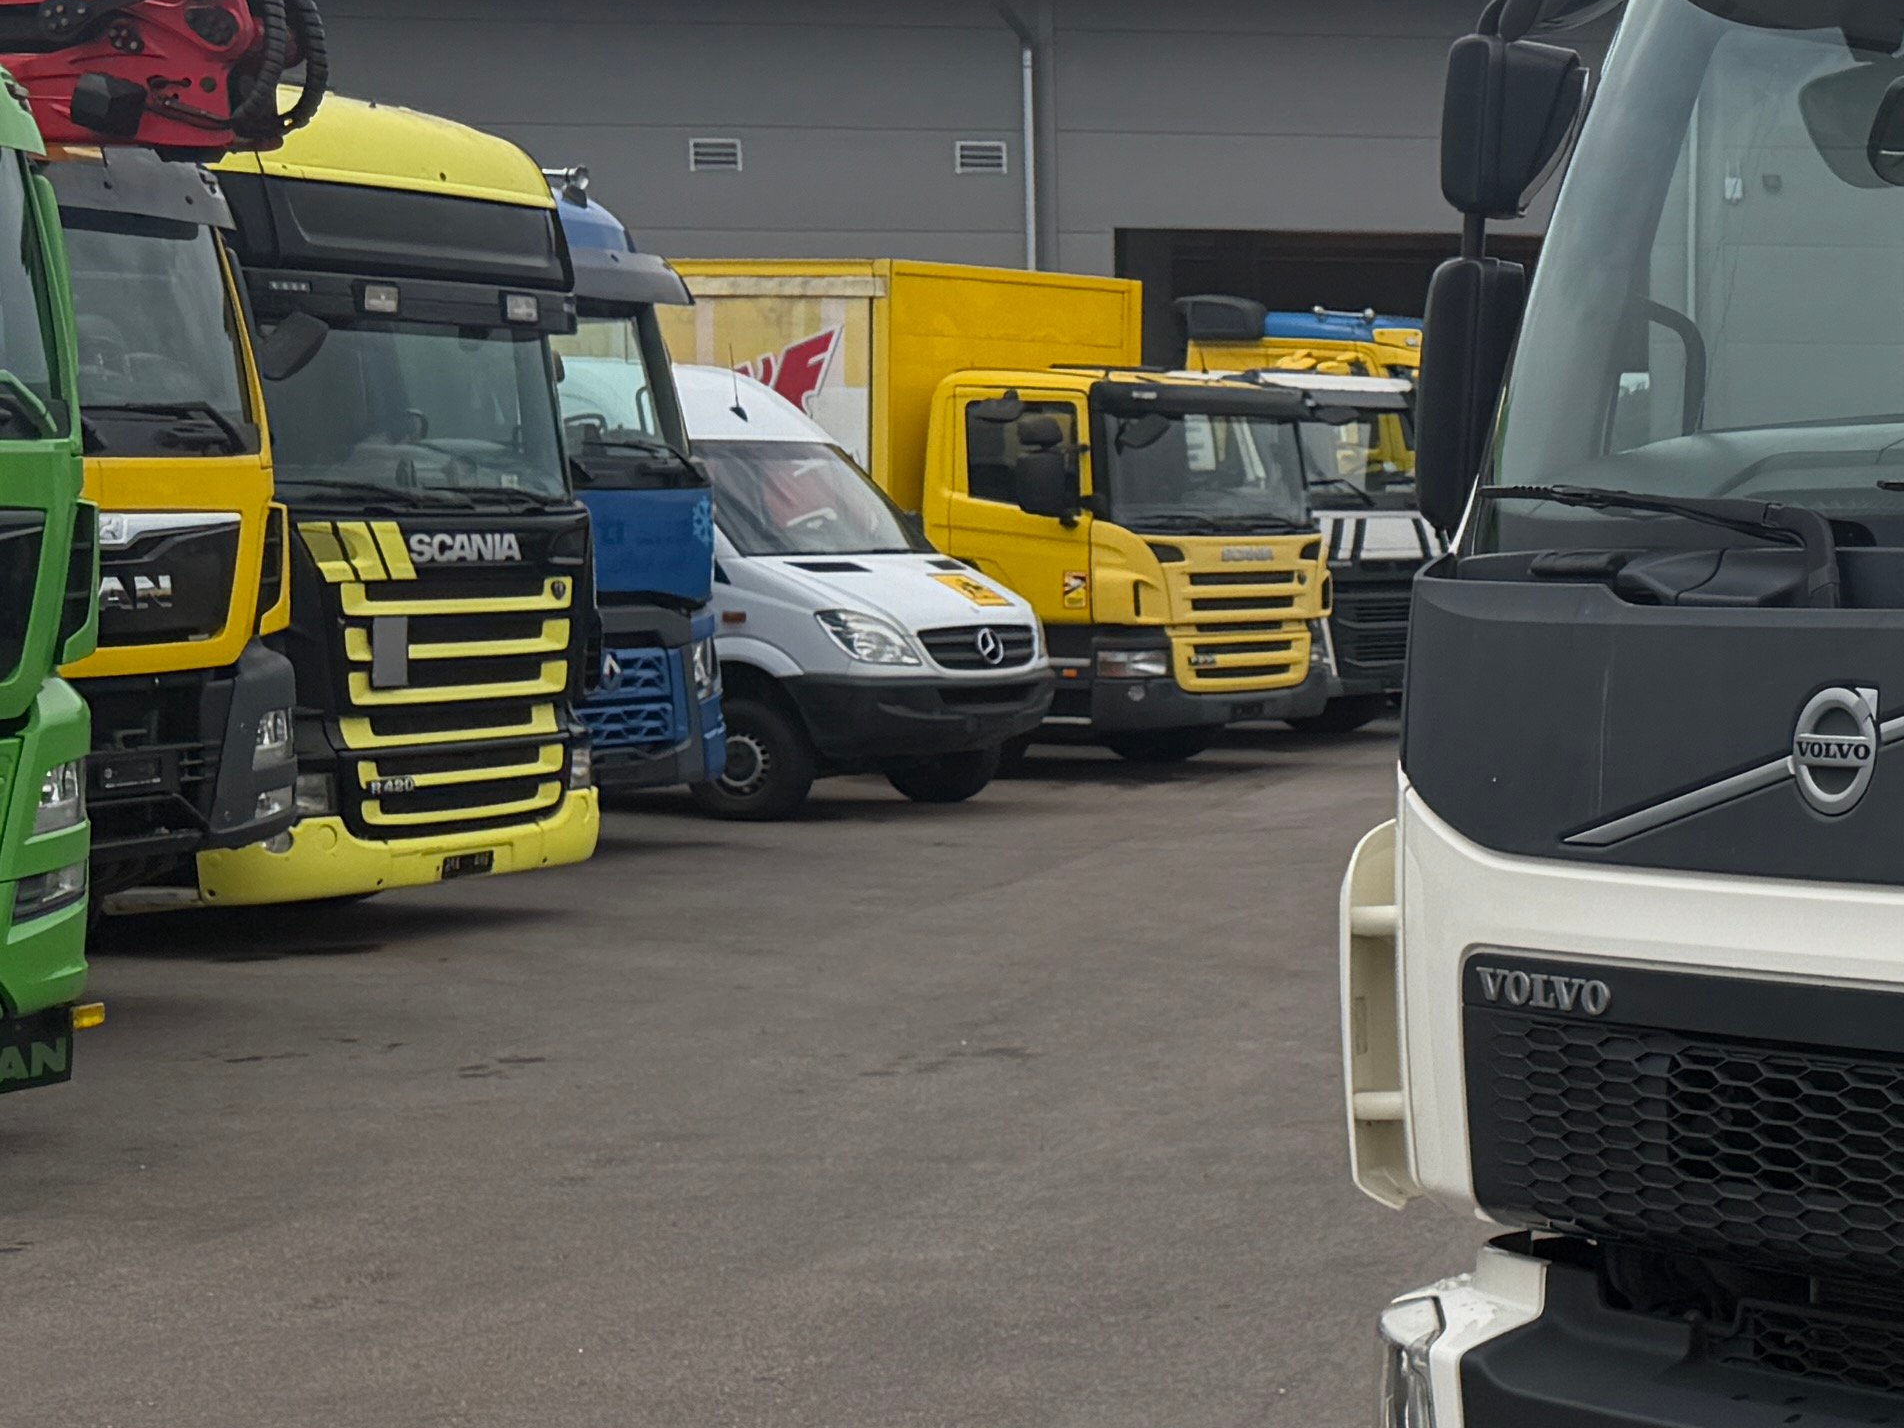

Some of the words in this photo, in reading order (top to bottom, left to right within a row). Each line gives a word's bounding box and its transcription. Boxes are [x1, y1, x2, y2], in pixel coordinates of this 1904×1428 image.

[409, 533, 522, 562] SCANIA
[98, 575, 173, 610] AN
[1797, 740, 1871, 760] VOLVO
[1476, 966, 1611, 1015] VOLVO
[0, 1037, 67, 1083] AN
